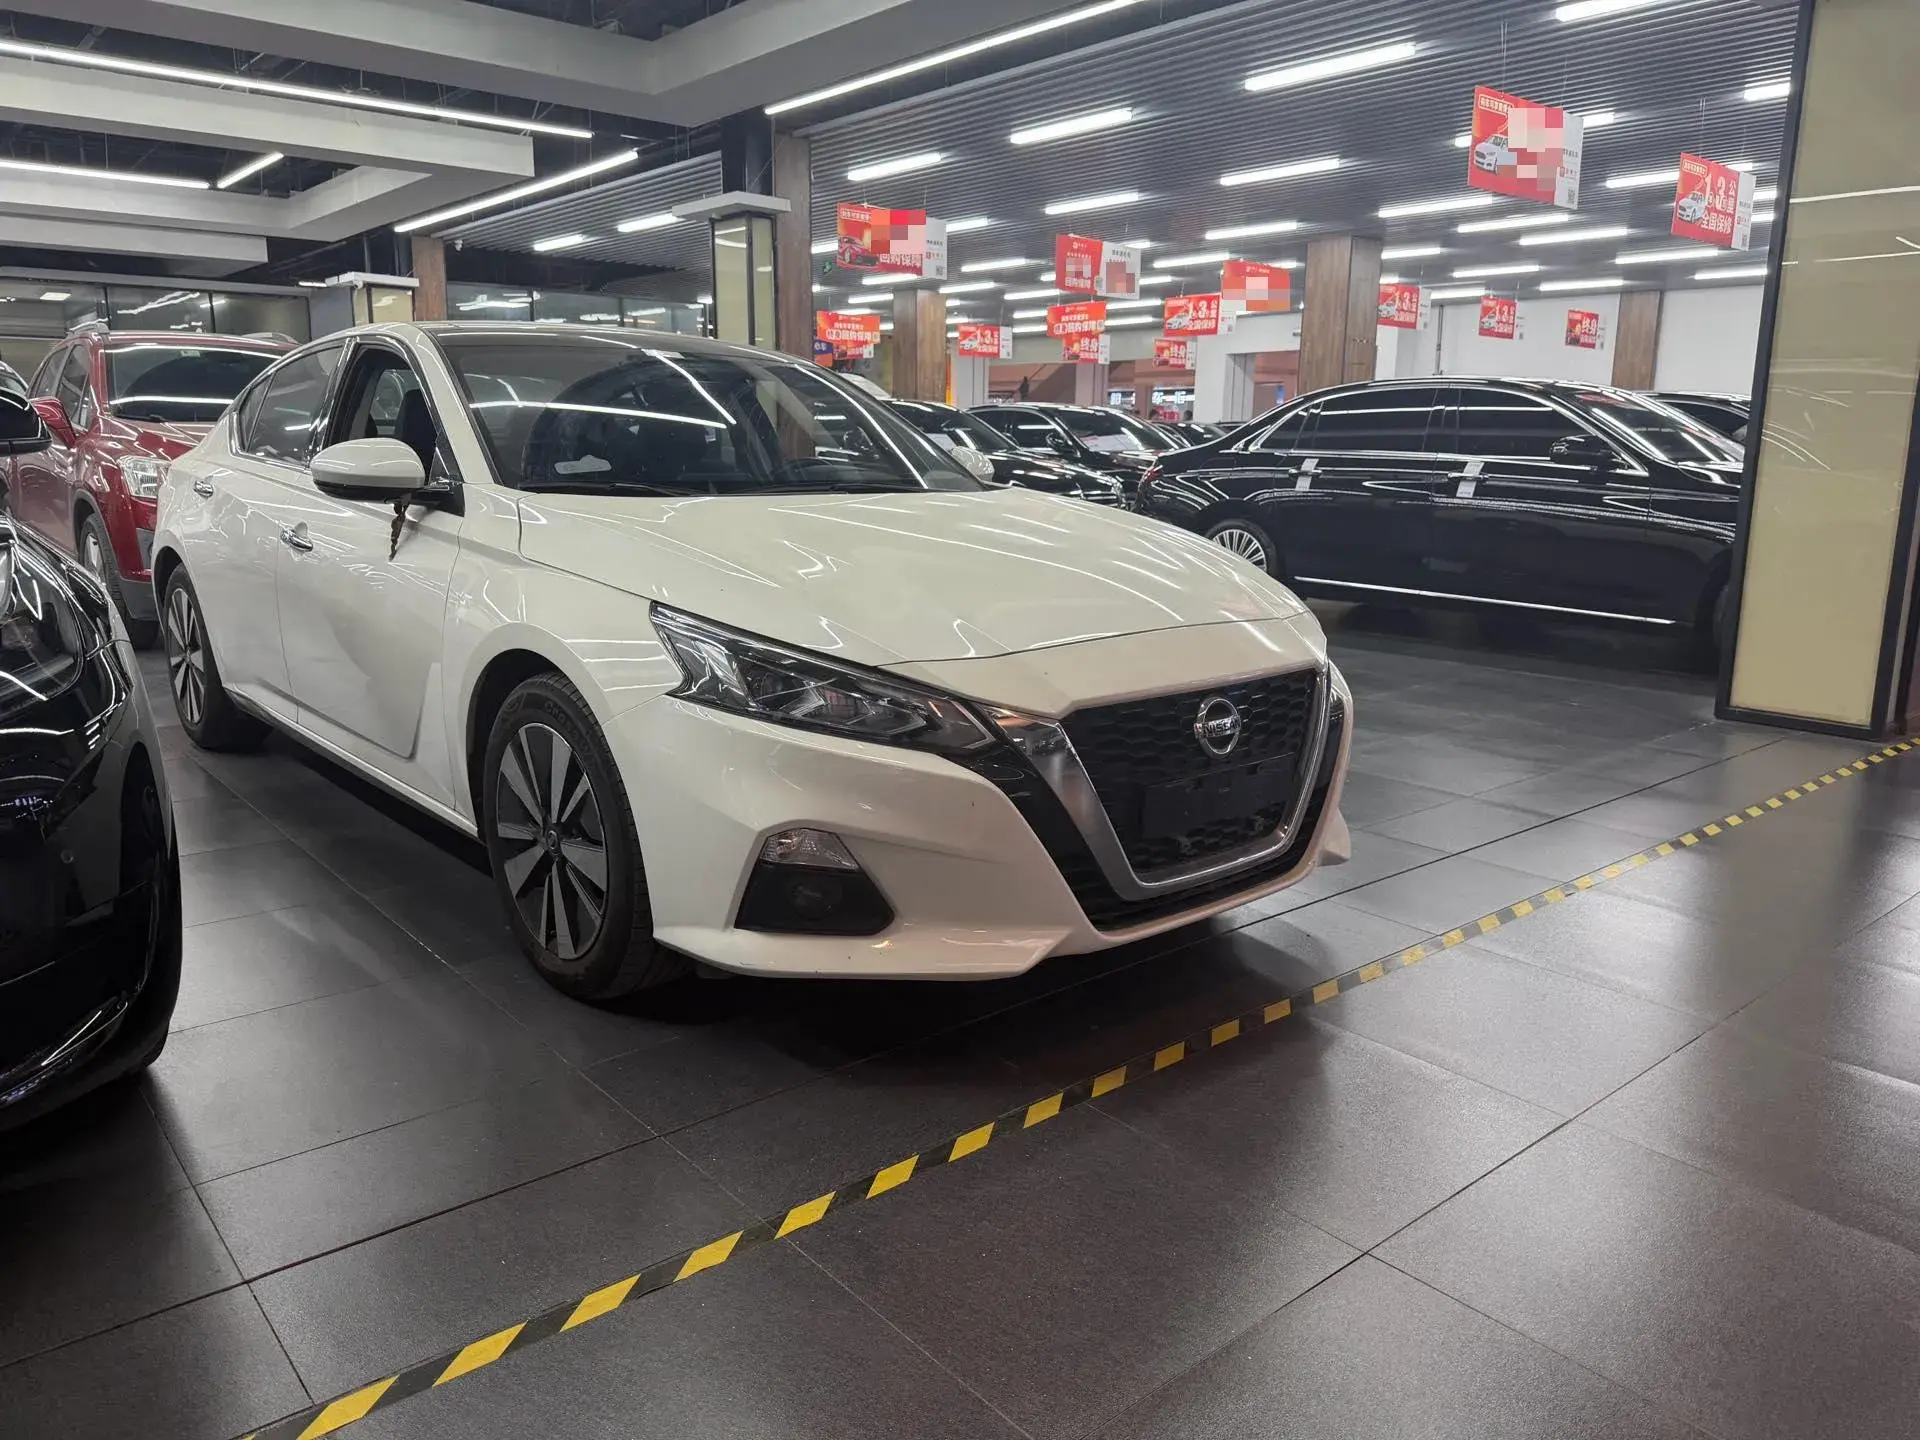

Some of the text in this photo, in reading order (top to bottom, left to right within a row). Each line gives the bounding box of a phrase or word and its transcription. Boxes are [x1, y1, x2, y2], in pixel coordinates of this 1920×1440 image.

[1701, 210, 1732, 234] 全国保修
[1205, 717, 1240, 736] NISSAN
